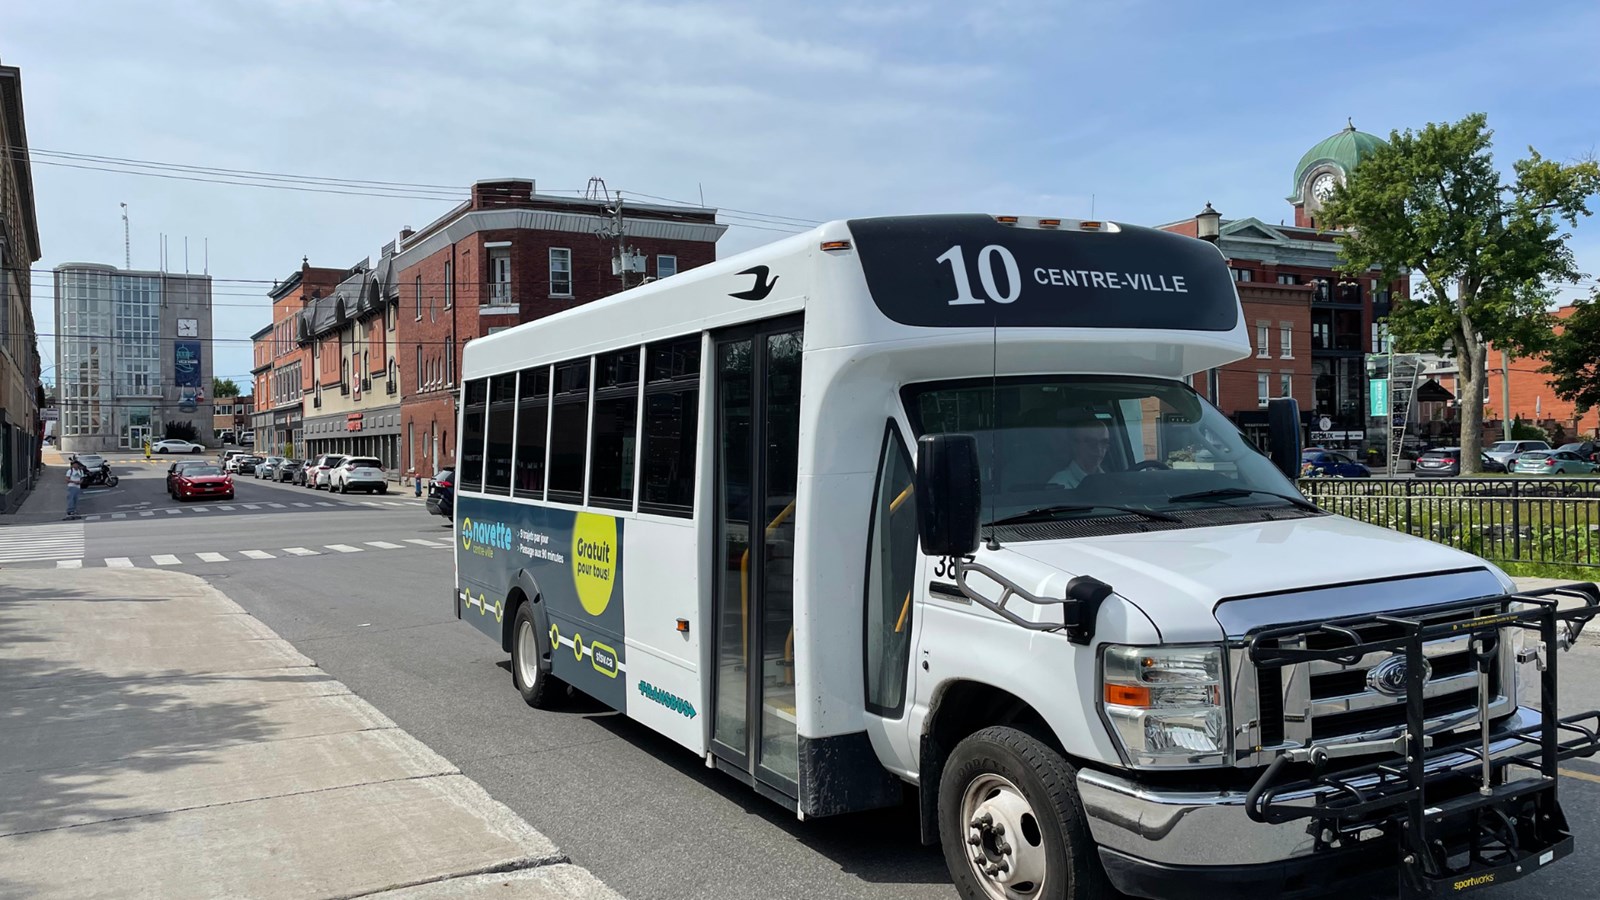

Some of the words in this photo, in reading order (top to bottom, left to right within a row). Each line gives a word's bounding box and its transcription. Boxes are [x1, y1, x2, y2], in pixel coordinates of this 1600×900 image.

[936, 244, 1022, 305] 10
[1033, 267, 1188, 293] CENTRE-VILLE
[473, 521, 512, 551] navette
[540, 532, 549, 546] jour
[547, 551, 564, 564] minutes
[577, 537, 610, 564] Gratuit
[577, 562, 592, 577] pour
[593, 564, 610, 581] tous!
[595, 651, 613, 668] stsv.ca
[639, 680, 691, 718] TRANSBUS
[1453, 873, 1495, 891] sportworks
